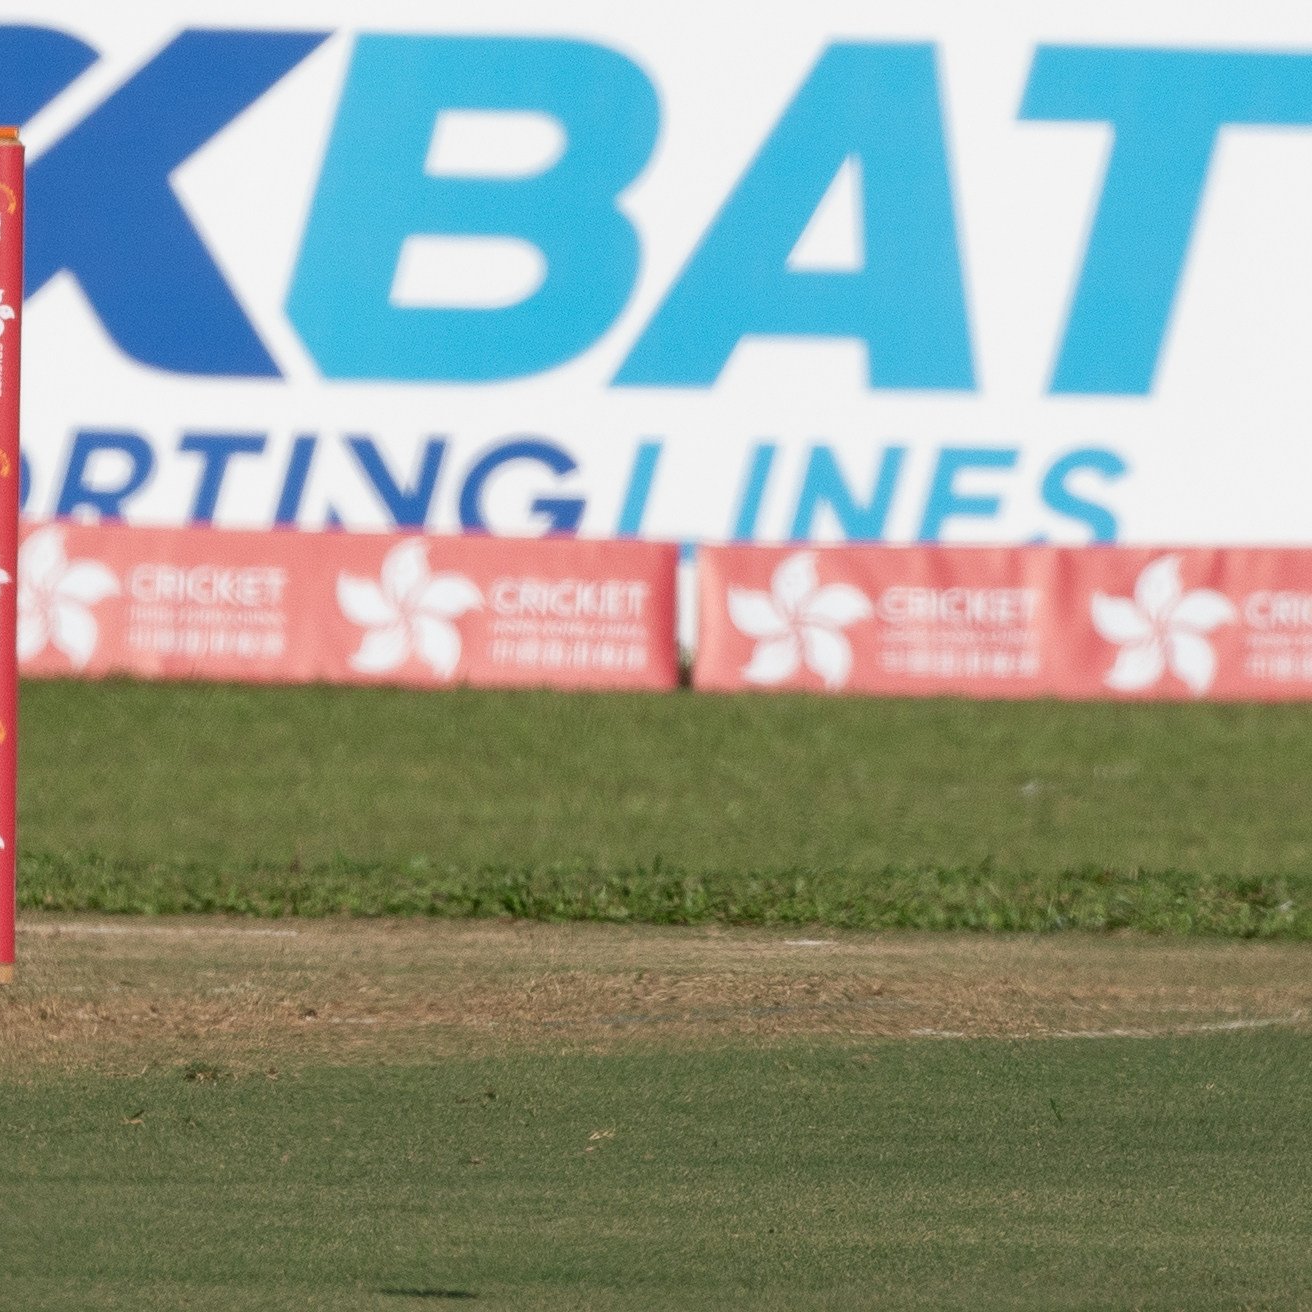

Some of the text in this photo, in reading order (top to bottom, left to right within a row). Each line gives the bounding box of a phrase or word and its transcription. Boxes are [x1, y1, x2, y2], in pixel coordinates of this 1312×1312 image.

[130, 564, 286, 605] CRICKET
[492, 578, 646, 618] CRICKET
[882, 587, 1041, 625] CRICKET
